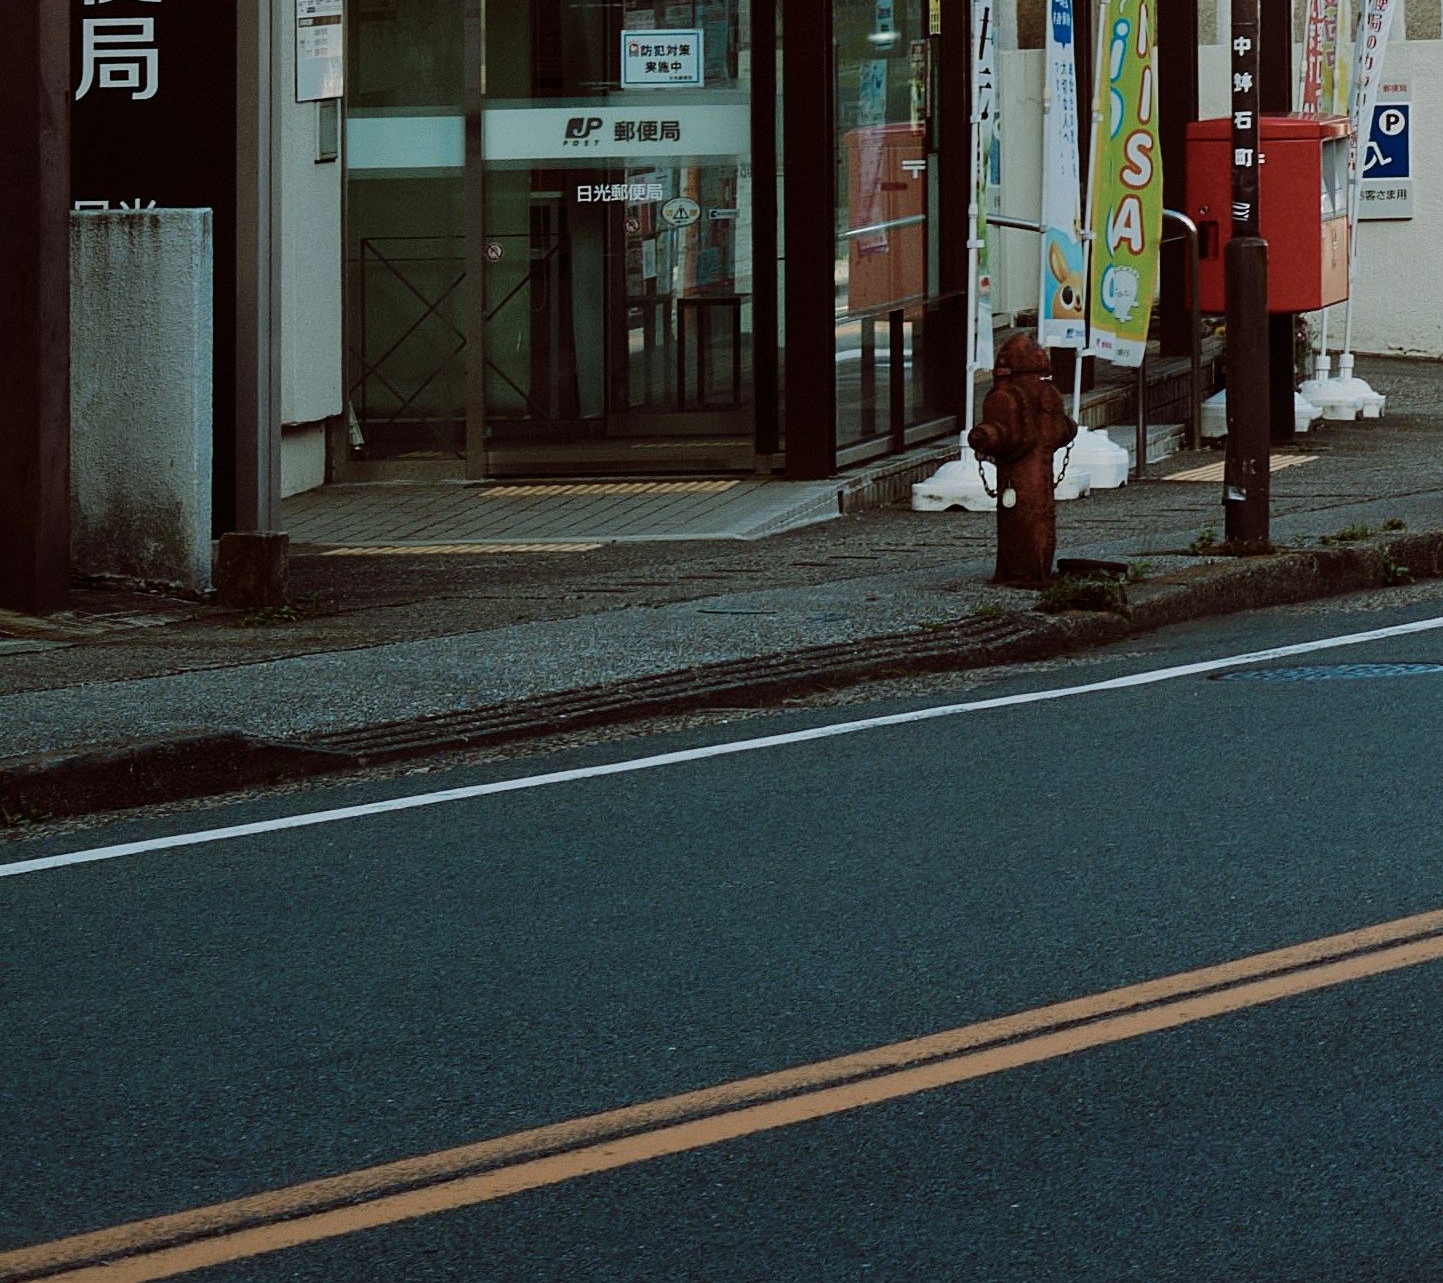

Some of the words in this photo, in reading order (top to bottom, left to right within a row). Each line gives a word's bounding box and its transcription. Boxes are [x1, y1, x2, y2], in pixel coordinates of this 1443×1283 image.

[640, 44, 691, 57] 防犯対策
[644, 61, 683, 74] 実施中
[1233, 35, 1254, 167] 中鉢石町
[613, 120, 681, 143] 郵便局
[1387, 113, 1400, 131] P
[576, 183, 664, 203] 日光郵便局
